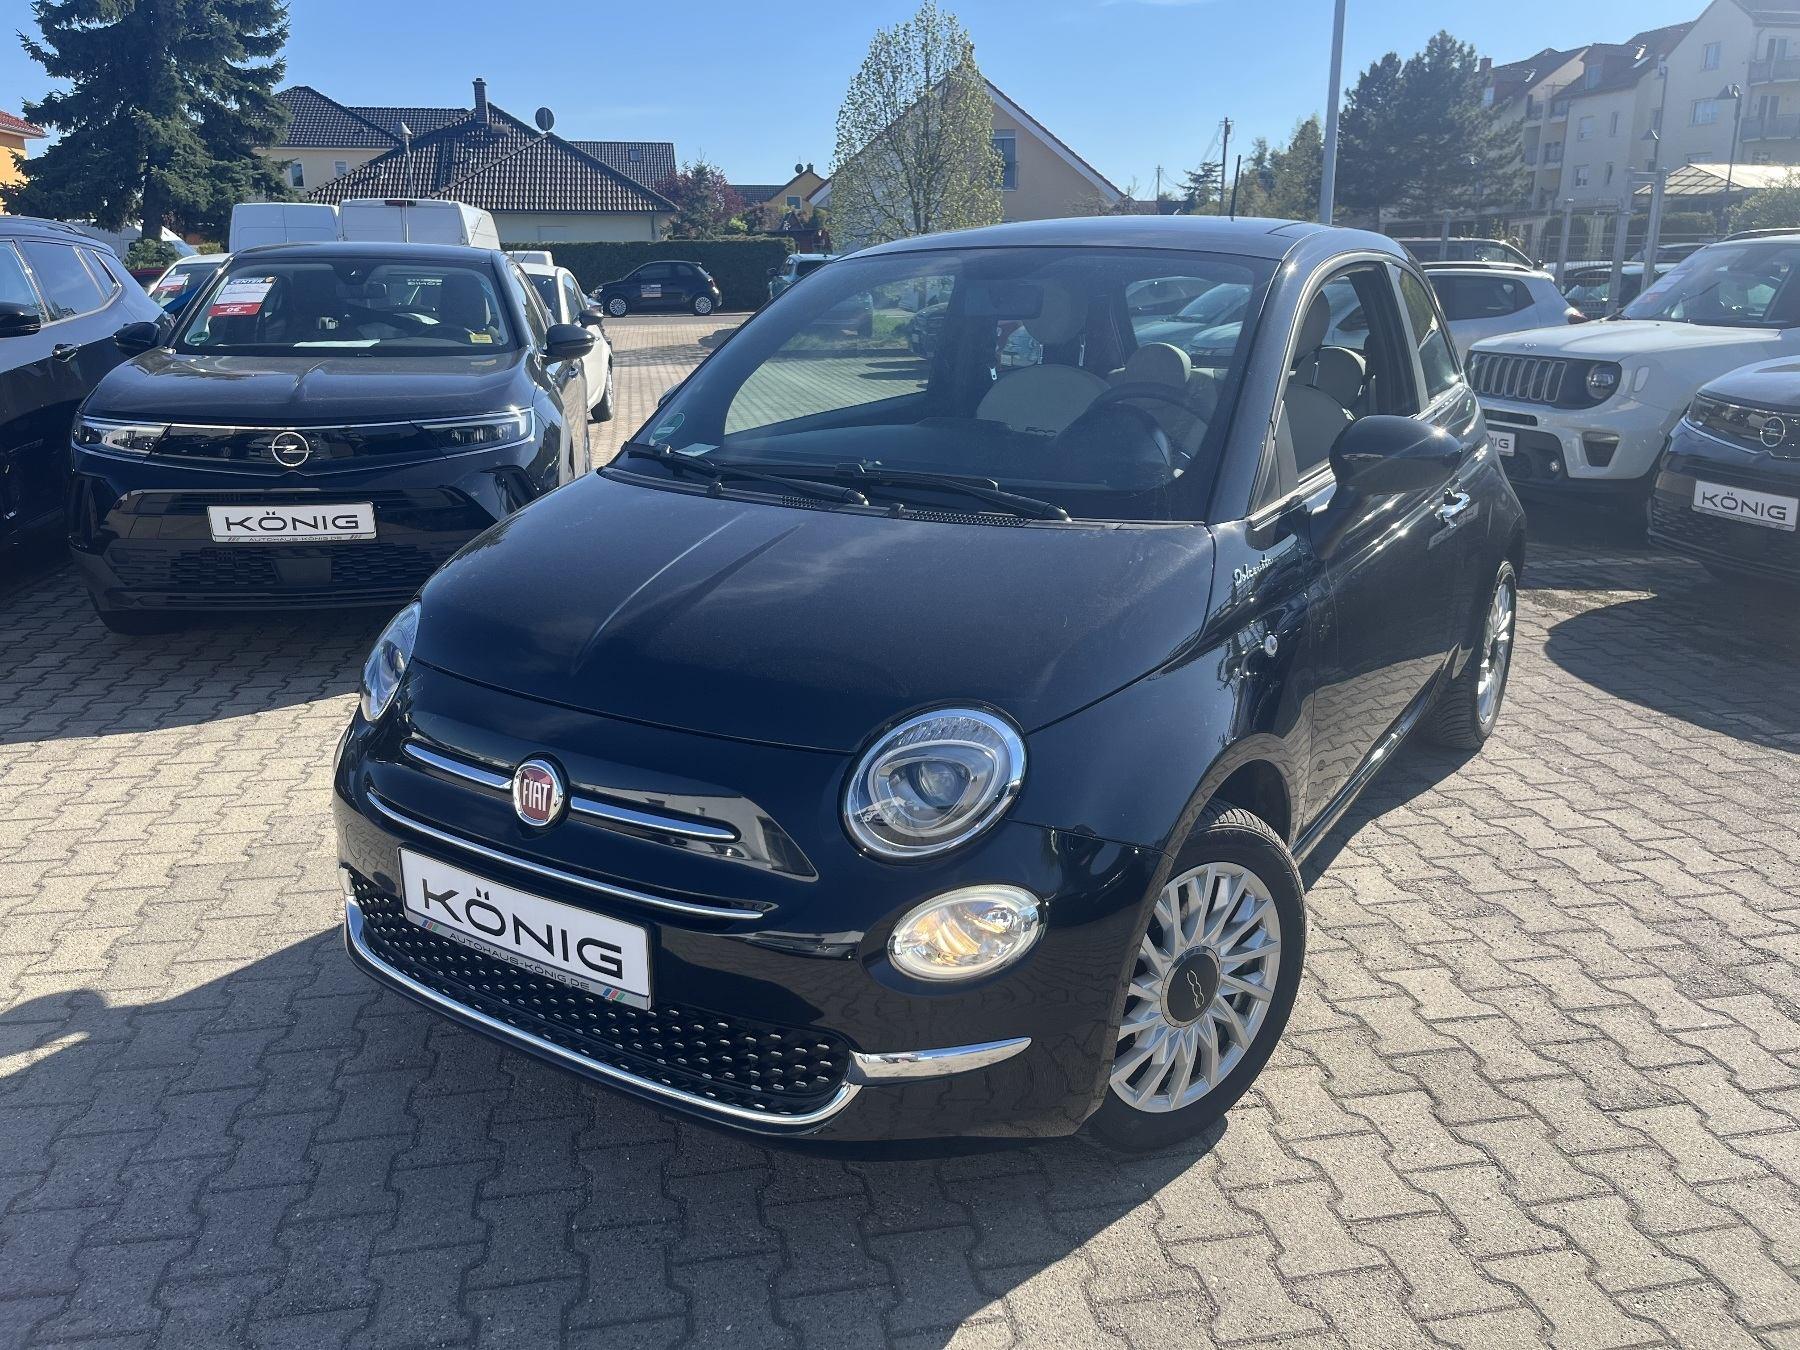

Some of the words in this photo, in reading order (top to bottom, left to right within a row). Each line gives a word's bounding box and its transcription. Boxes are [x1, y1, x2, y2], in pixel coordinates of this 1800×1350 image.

[1486, 432, 1509, 449] NIG
[225, 510, 359, 532] KÖNIG
[1701, 491, 1787, 521] KÖNIG
[522, 777, 551, 812] FIAT
[422, 878, 624, 980] KÖNIG
